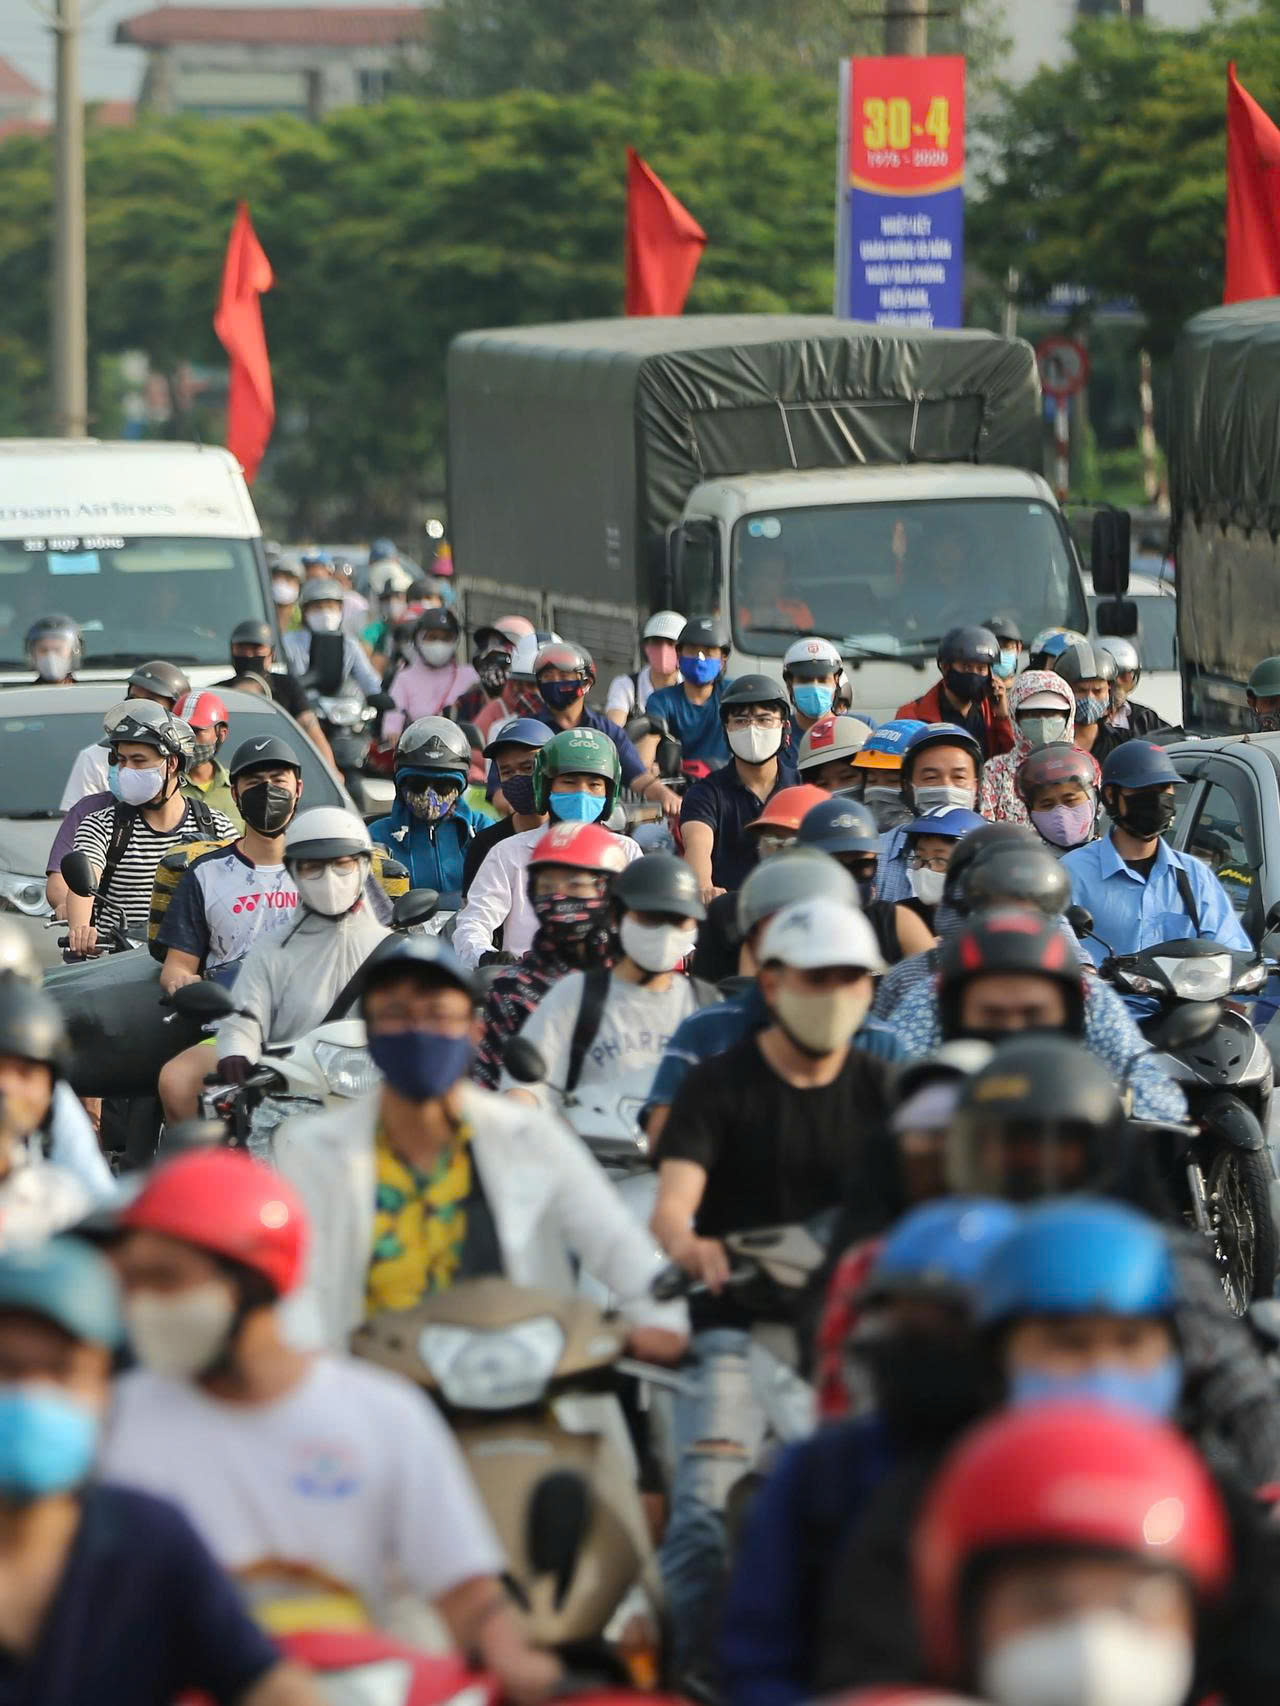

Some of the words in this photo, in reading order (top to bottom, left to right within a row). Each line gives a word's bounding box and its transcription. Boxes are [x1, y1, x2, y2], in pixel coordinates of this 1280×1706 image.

[863, 96, 950, 150] 30-4
[78, 500, 177, 519] Airlines
[569, 739, 600, 750] Grab
